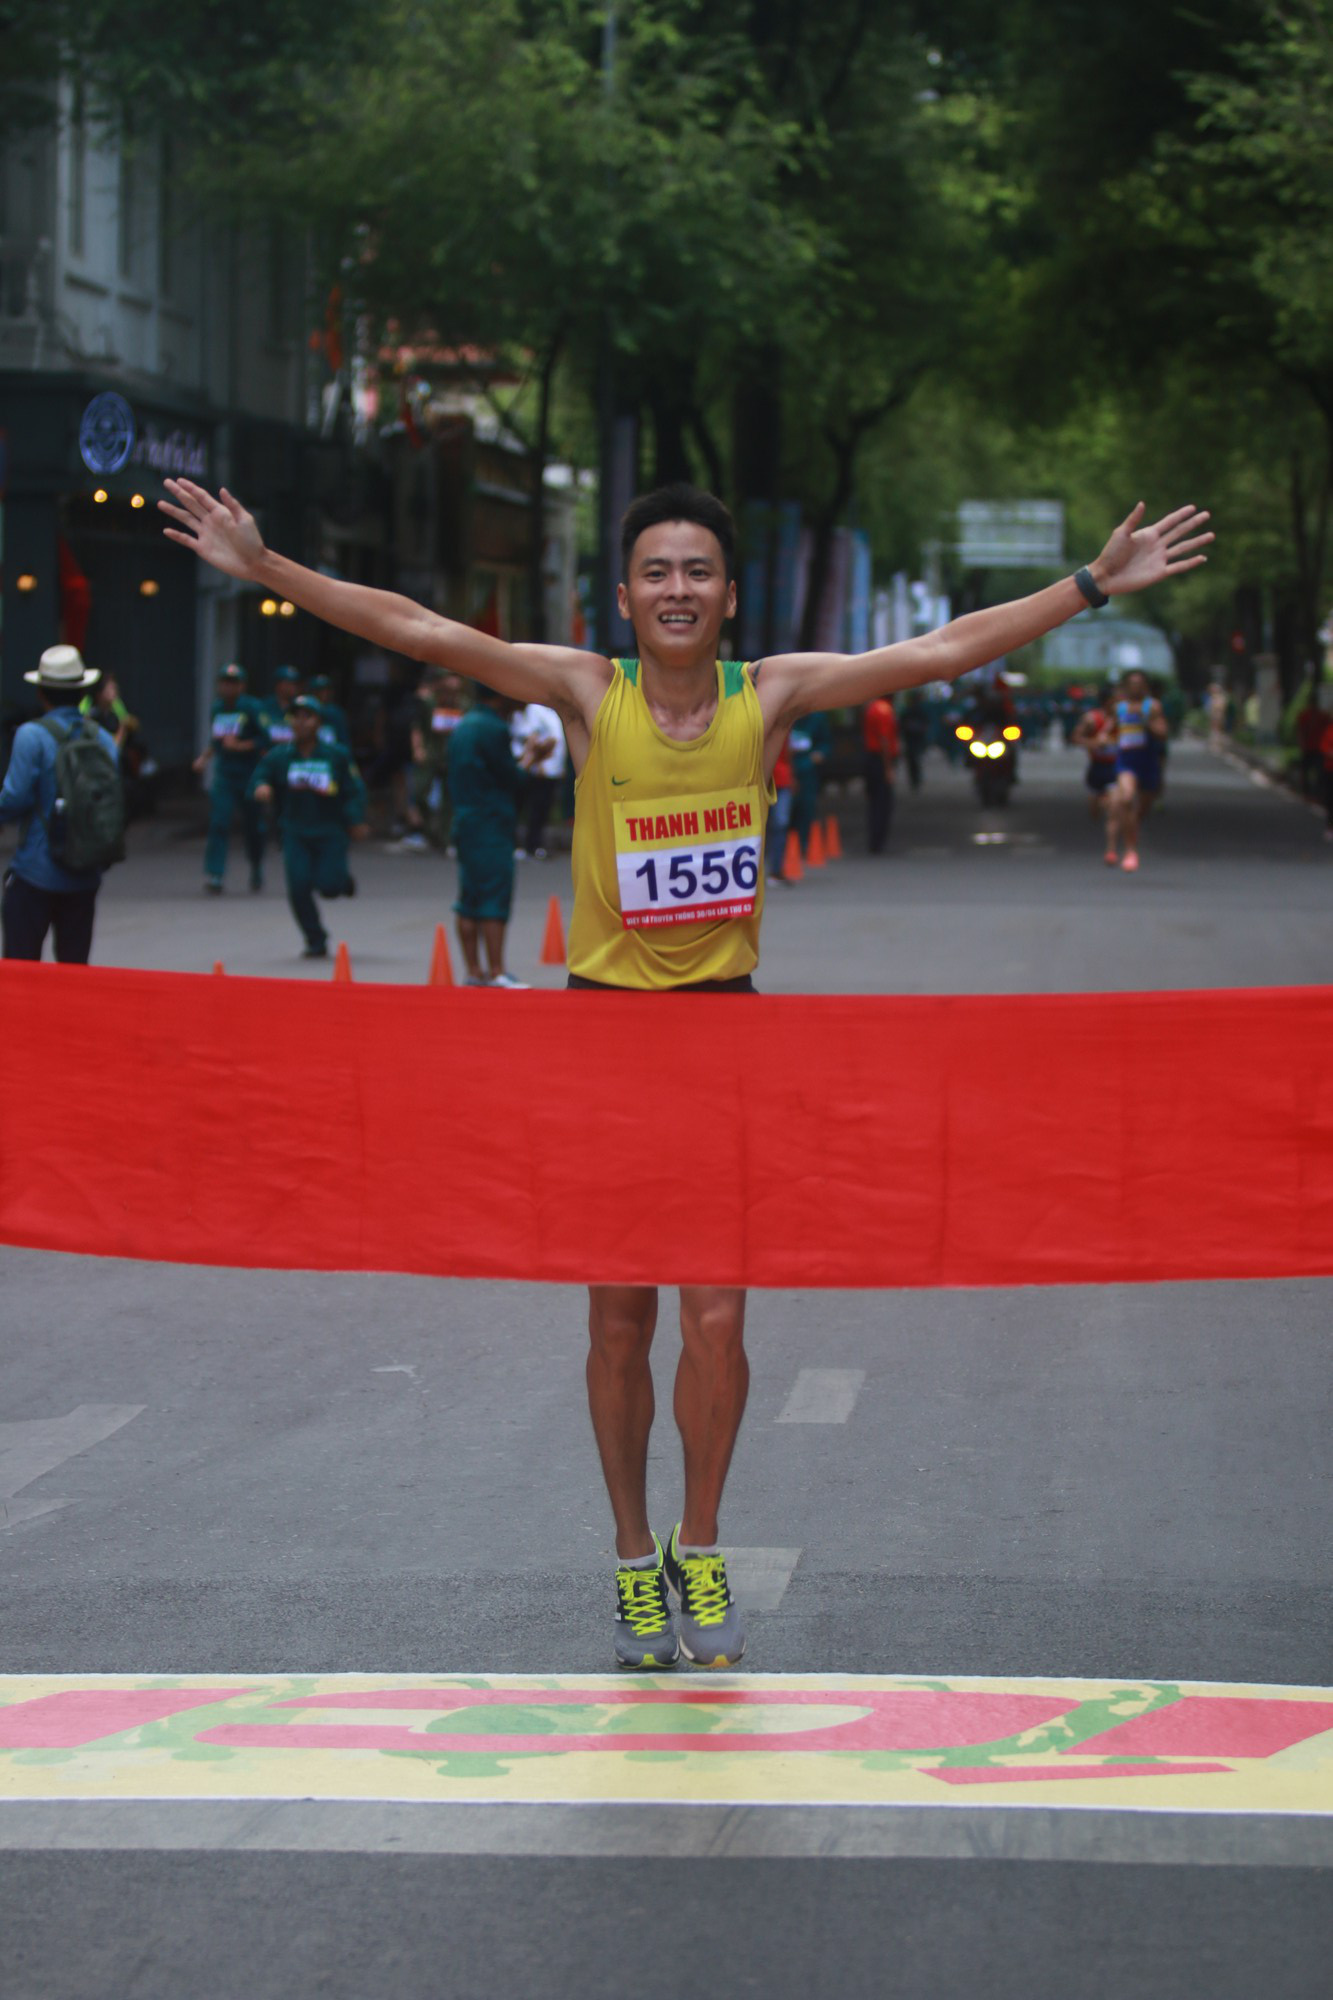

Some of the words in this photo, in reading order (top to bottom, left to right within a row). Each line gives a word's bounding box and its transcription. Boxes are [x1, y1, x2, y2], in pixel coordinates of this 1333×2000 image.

[626, 811, 699, 841] THANH
[703, 800, 752, 833] NIÊN
[636, 845, 758, 902] 1556
